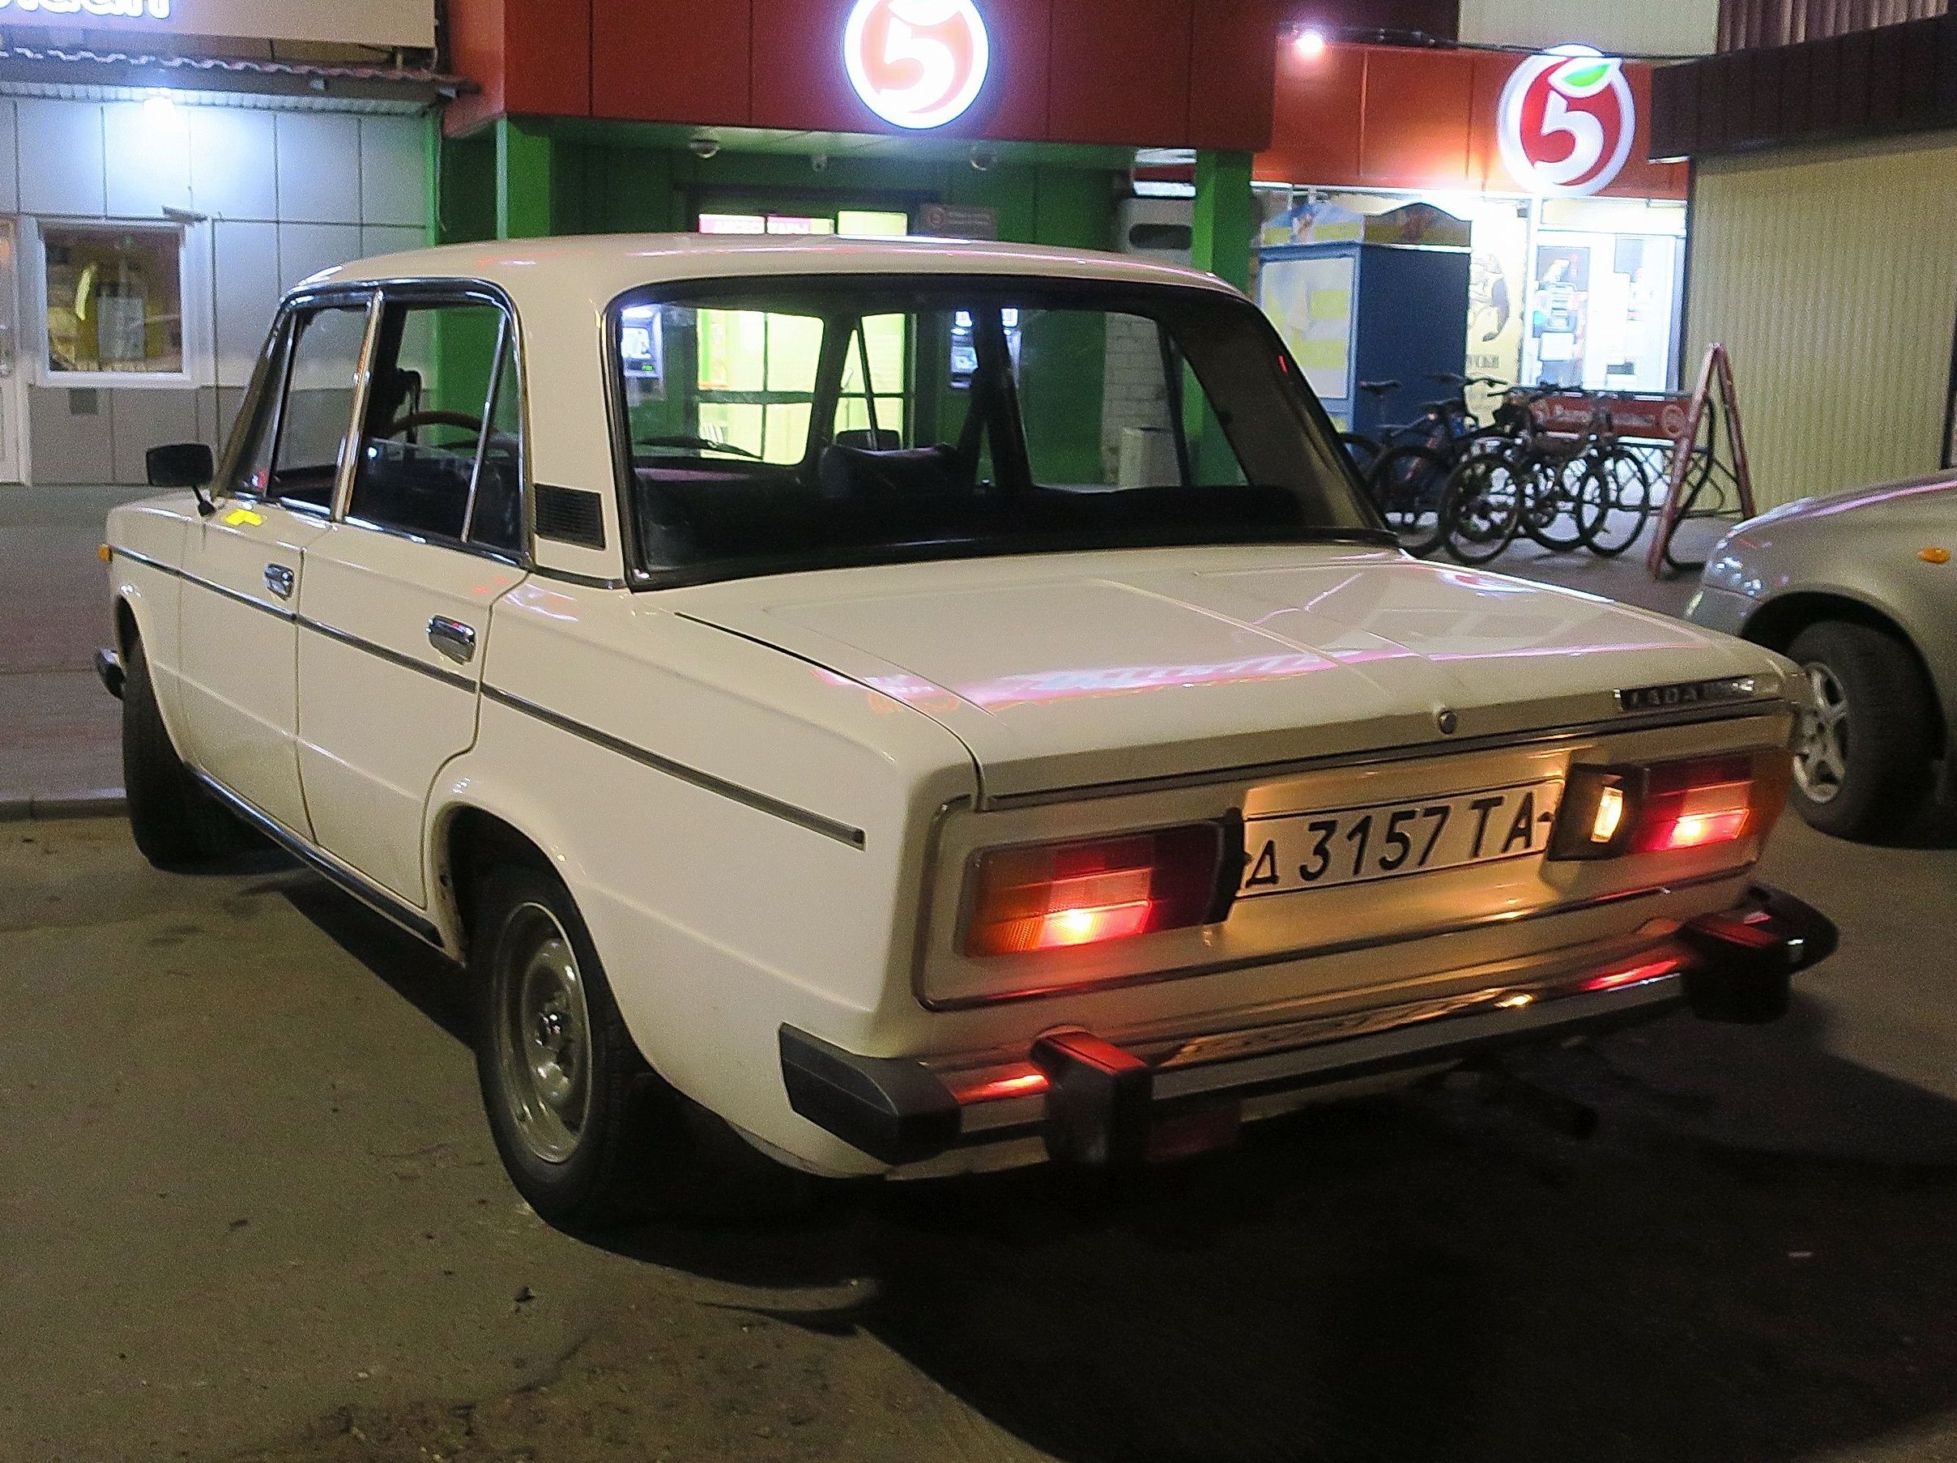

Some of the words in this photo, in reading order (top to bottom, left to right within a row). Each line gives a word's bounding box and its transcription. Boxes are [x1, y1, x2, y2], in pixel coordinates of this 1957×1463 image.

[1533, 88, 1605, 184] 5
[1299, 805, 1454, 881] 3157
[1471, 790, 1535, 858] ТА
